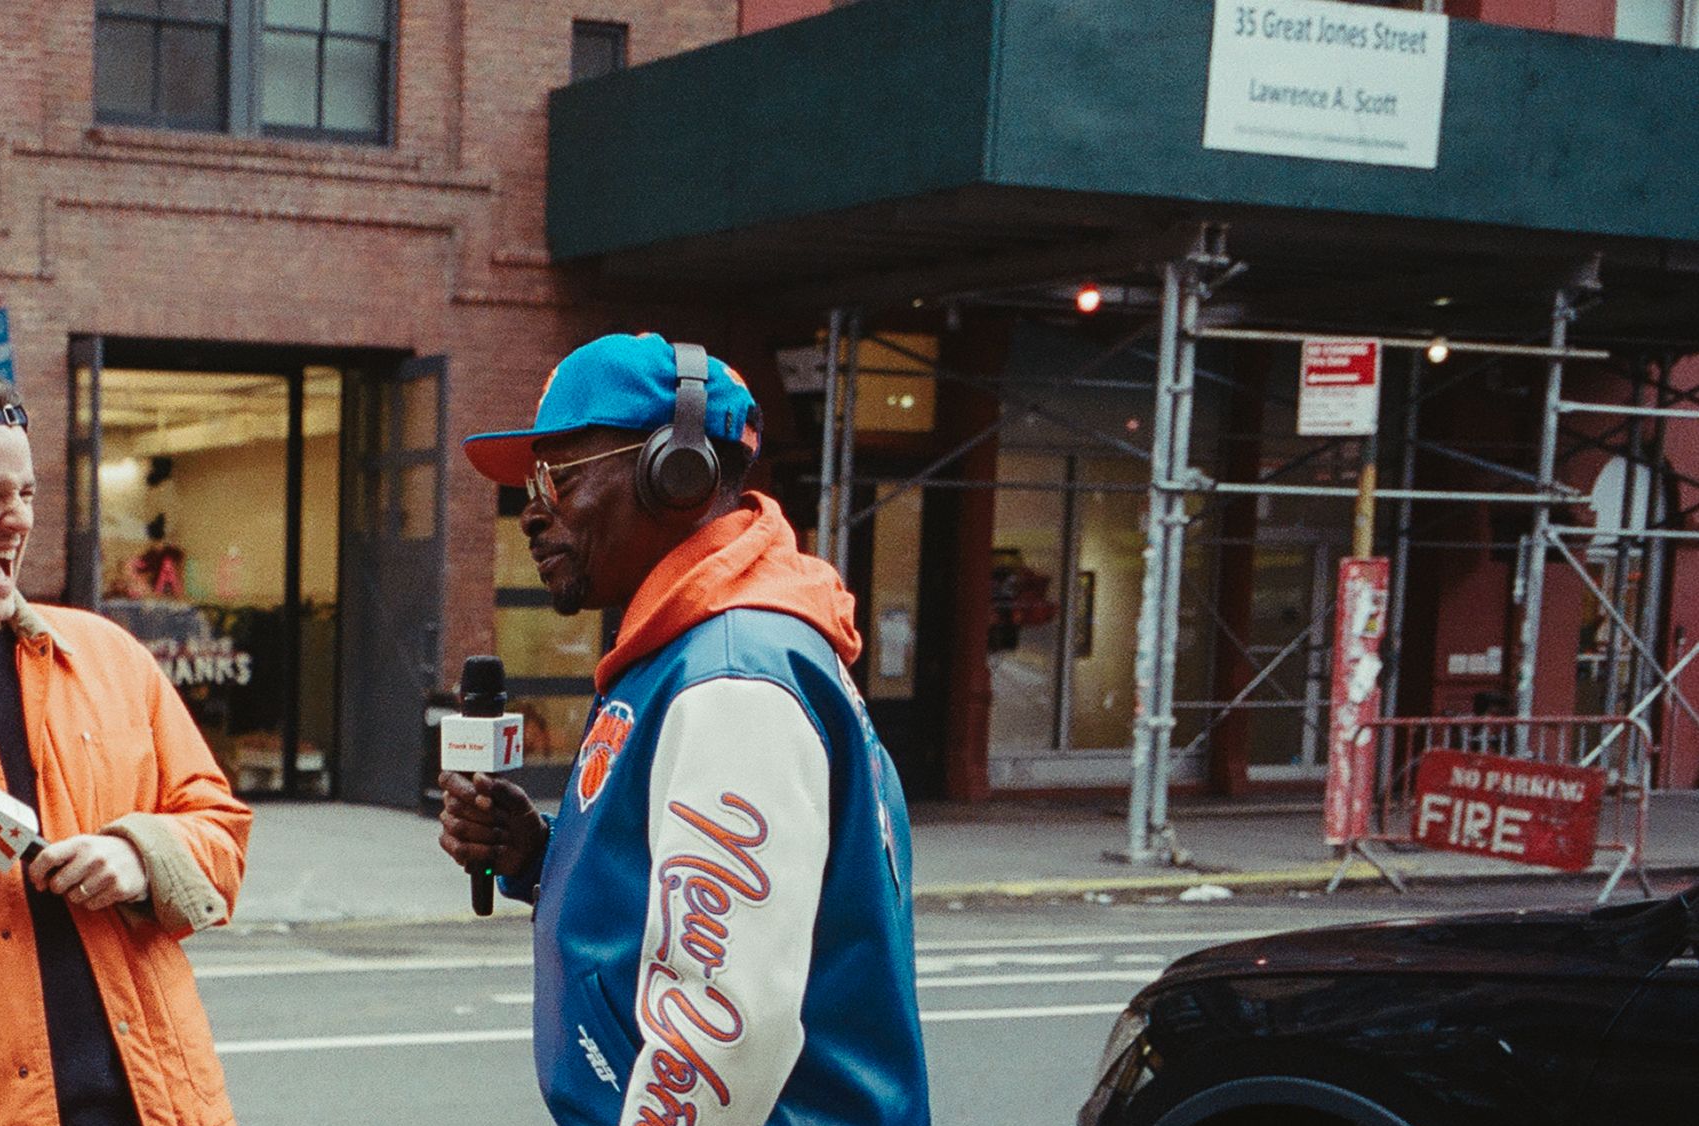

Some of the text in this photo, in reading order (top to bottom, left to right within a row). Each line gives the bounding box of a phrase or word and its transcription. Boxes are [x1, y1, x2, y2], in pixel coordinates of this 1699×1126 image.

[1235, 5, 1427, 54] 35 Great Jones Street
[1249, 78, 1398, 117] Lawrence A. Scott
[503, 725, 518, 764] T
[1451, 766, 1481, 789] NO
[1417, 792, 1533, 854] FIRE
[657, 792, 771, 980] New
